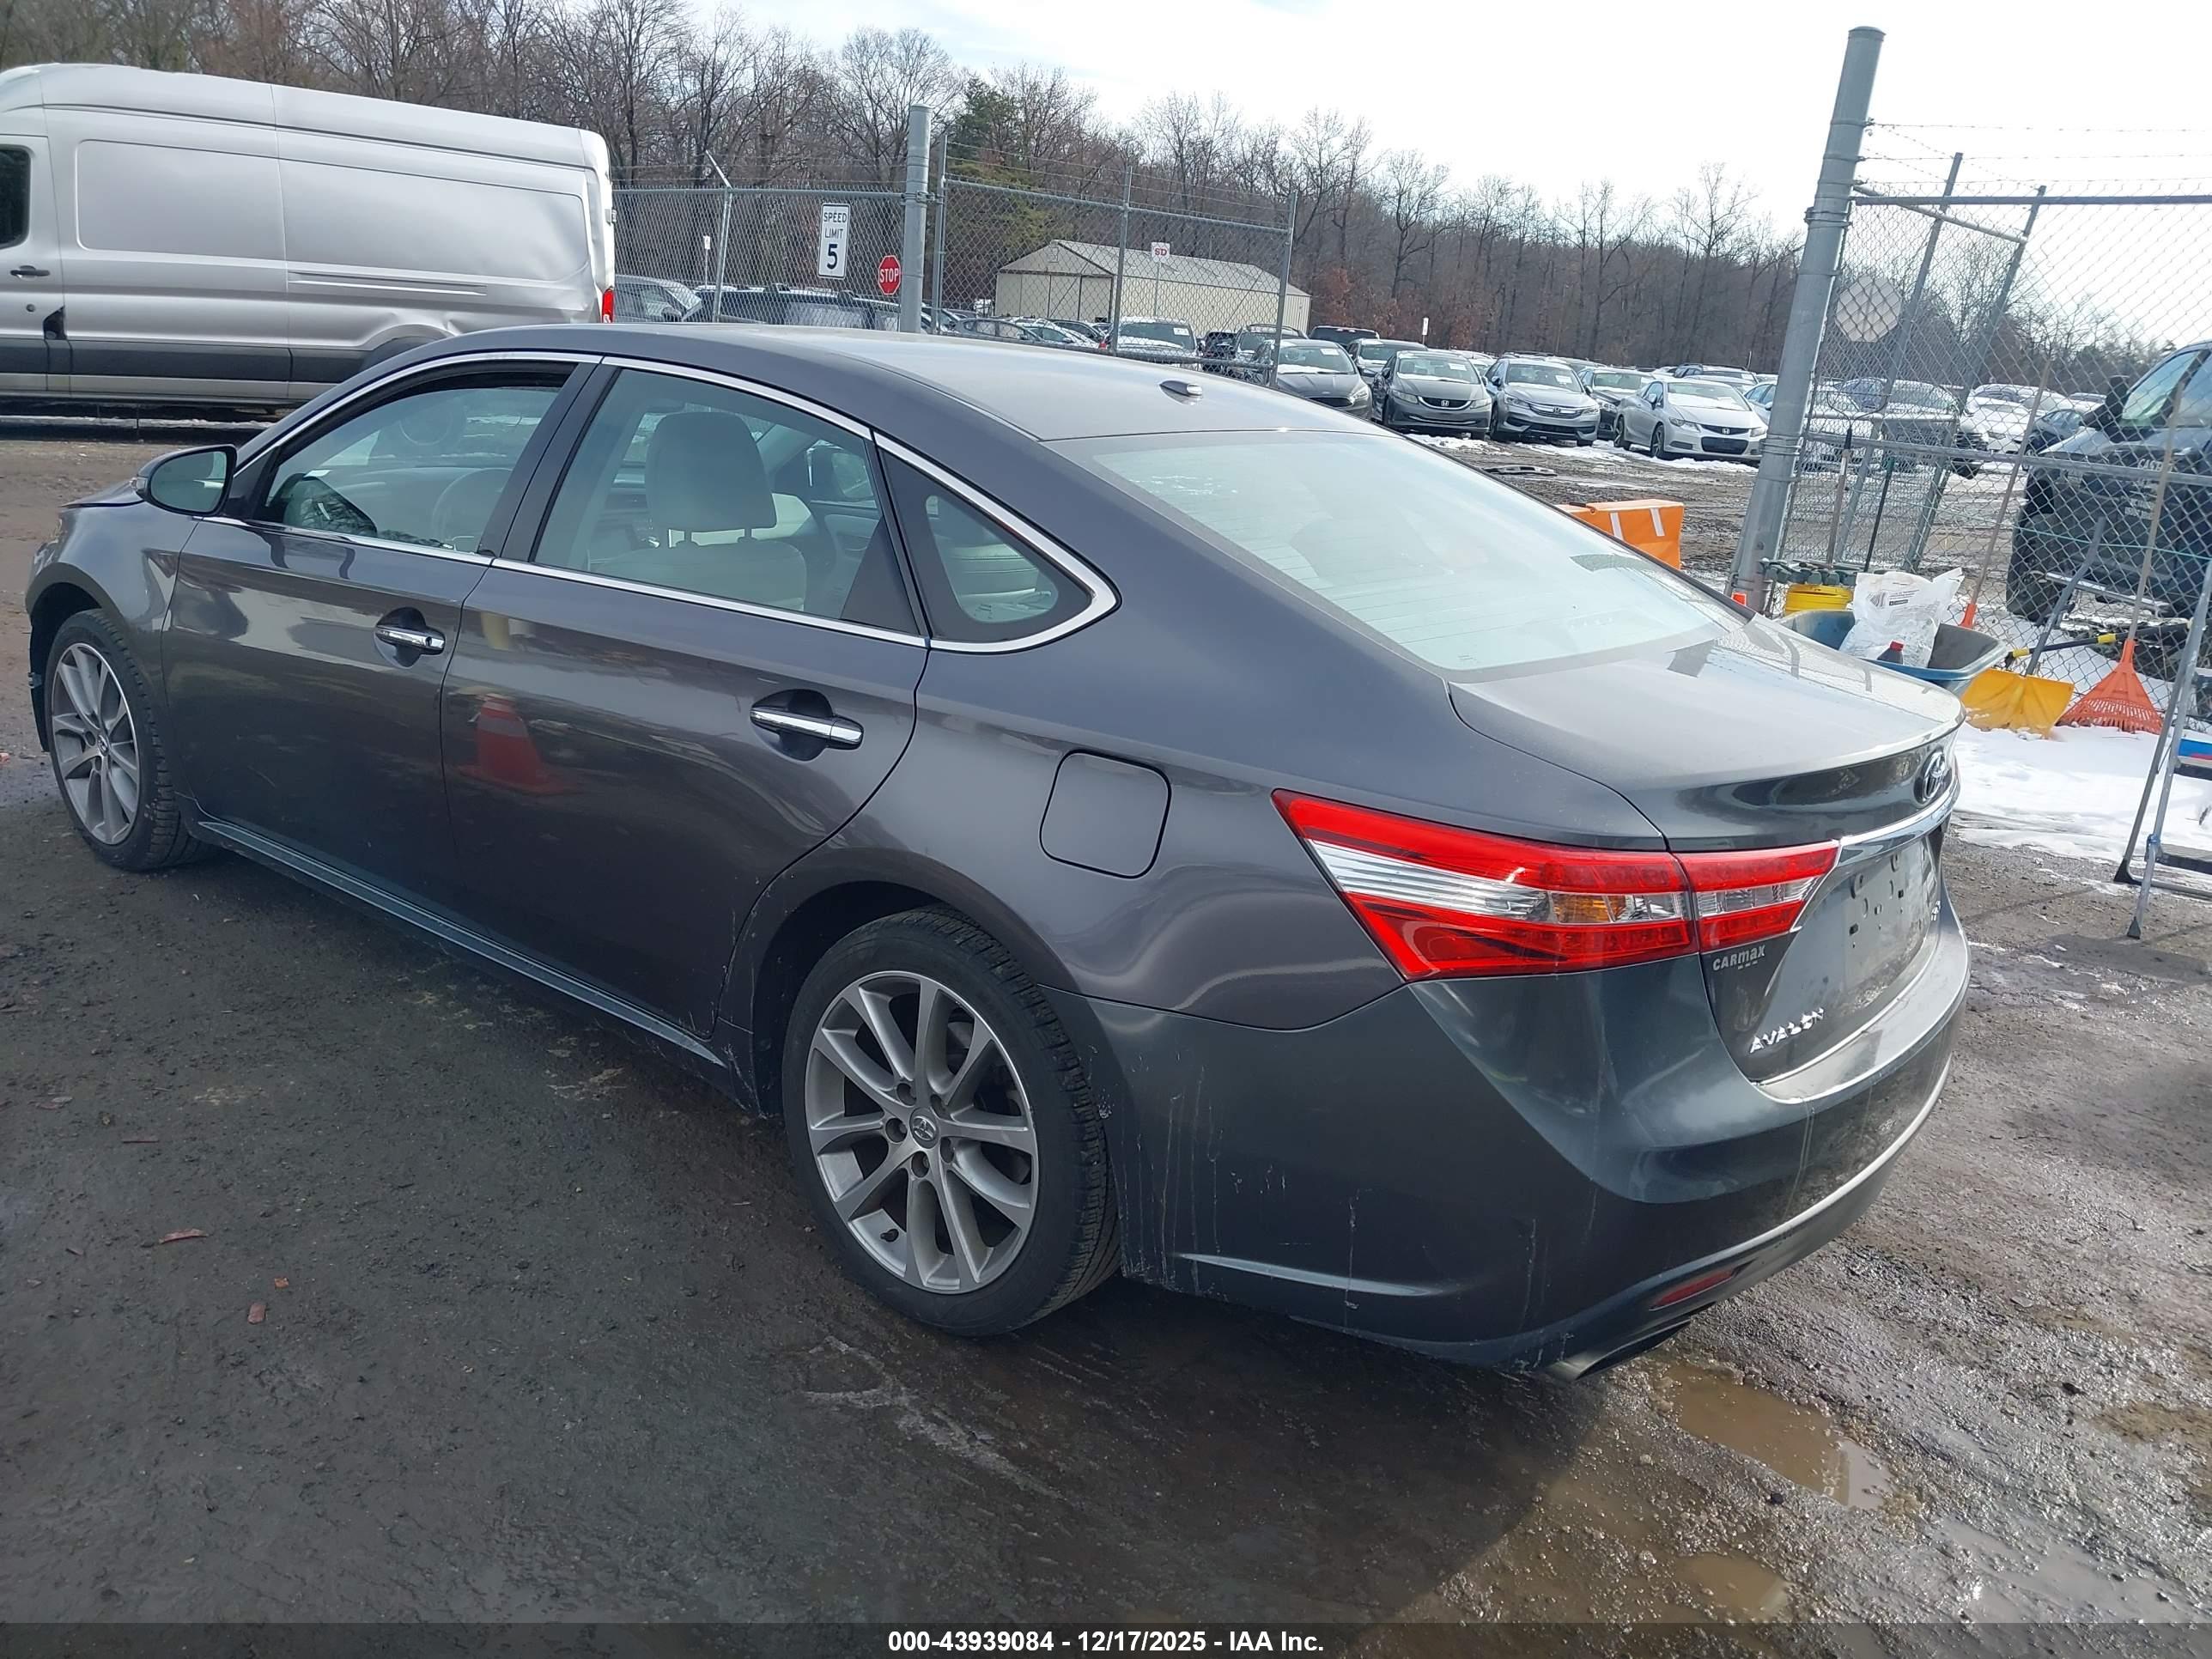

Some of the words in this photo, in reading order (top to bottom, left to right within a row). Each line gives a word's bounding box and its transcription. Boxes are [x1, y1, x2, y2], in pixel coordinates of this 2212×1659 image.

[823, 212, 848, 223] SPEED
[824, 228, 844, 239] LIMIT
[826, 244, 838, 270] 5
[1155, 247, 1168, 257] SD
[879, 268, 899, 283] STOP
[1748, 1007, 1825, 1054] AVALON
